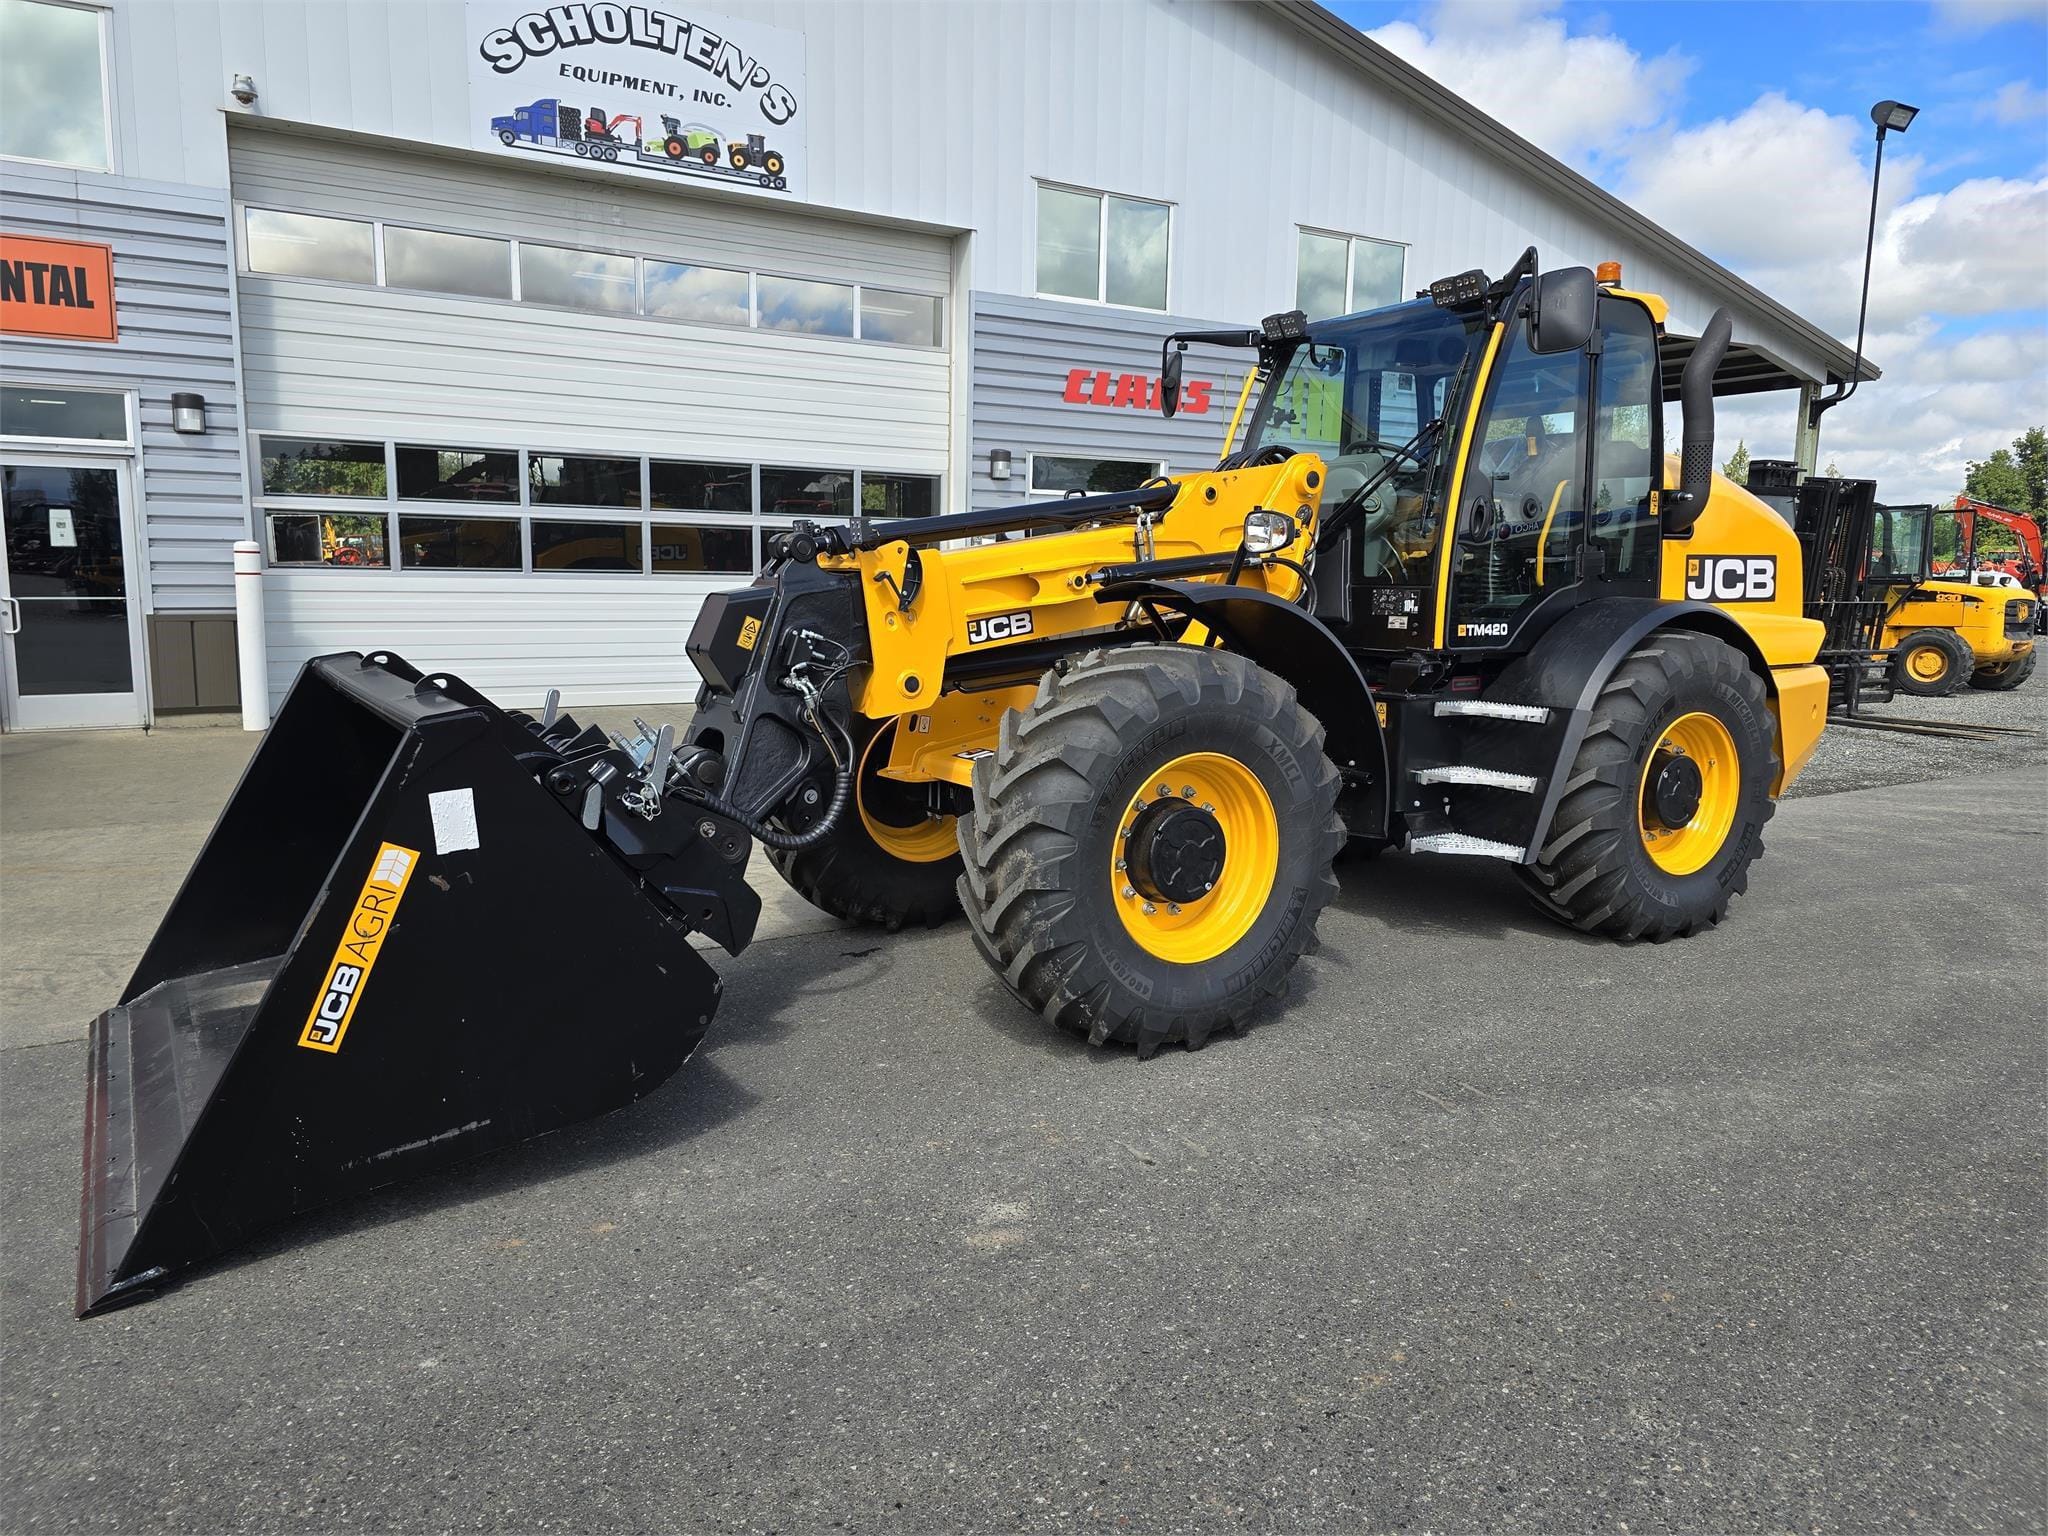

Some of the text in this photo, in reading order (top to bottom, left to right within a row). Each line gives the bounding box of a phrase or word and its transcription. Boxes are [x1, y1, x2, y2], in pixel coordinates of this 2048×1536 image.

[480, 2, 798, 125] SCHOLTEN'S
[559, 63, 733, 108] EQUIPMENT, INC.
[0, 259, 95, 309] NTAL
[1687, 559, 1775, 600] JCB
[969, 612, 1033, 643] JCB
[1467, 623, 1508, 636] TM420
[314, 885, 397, 1043] JCB AGRI
